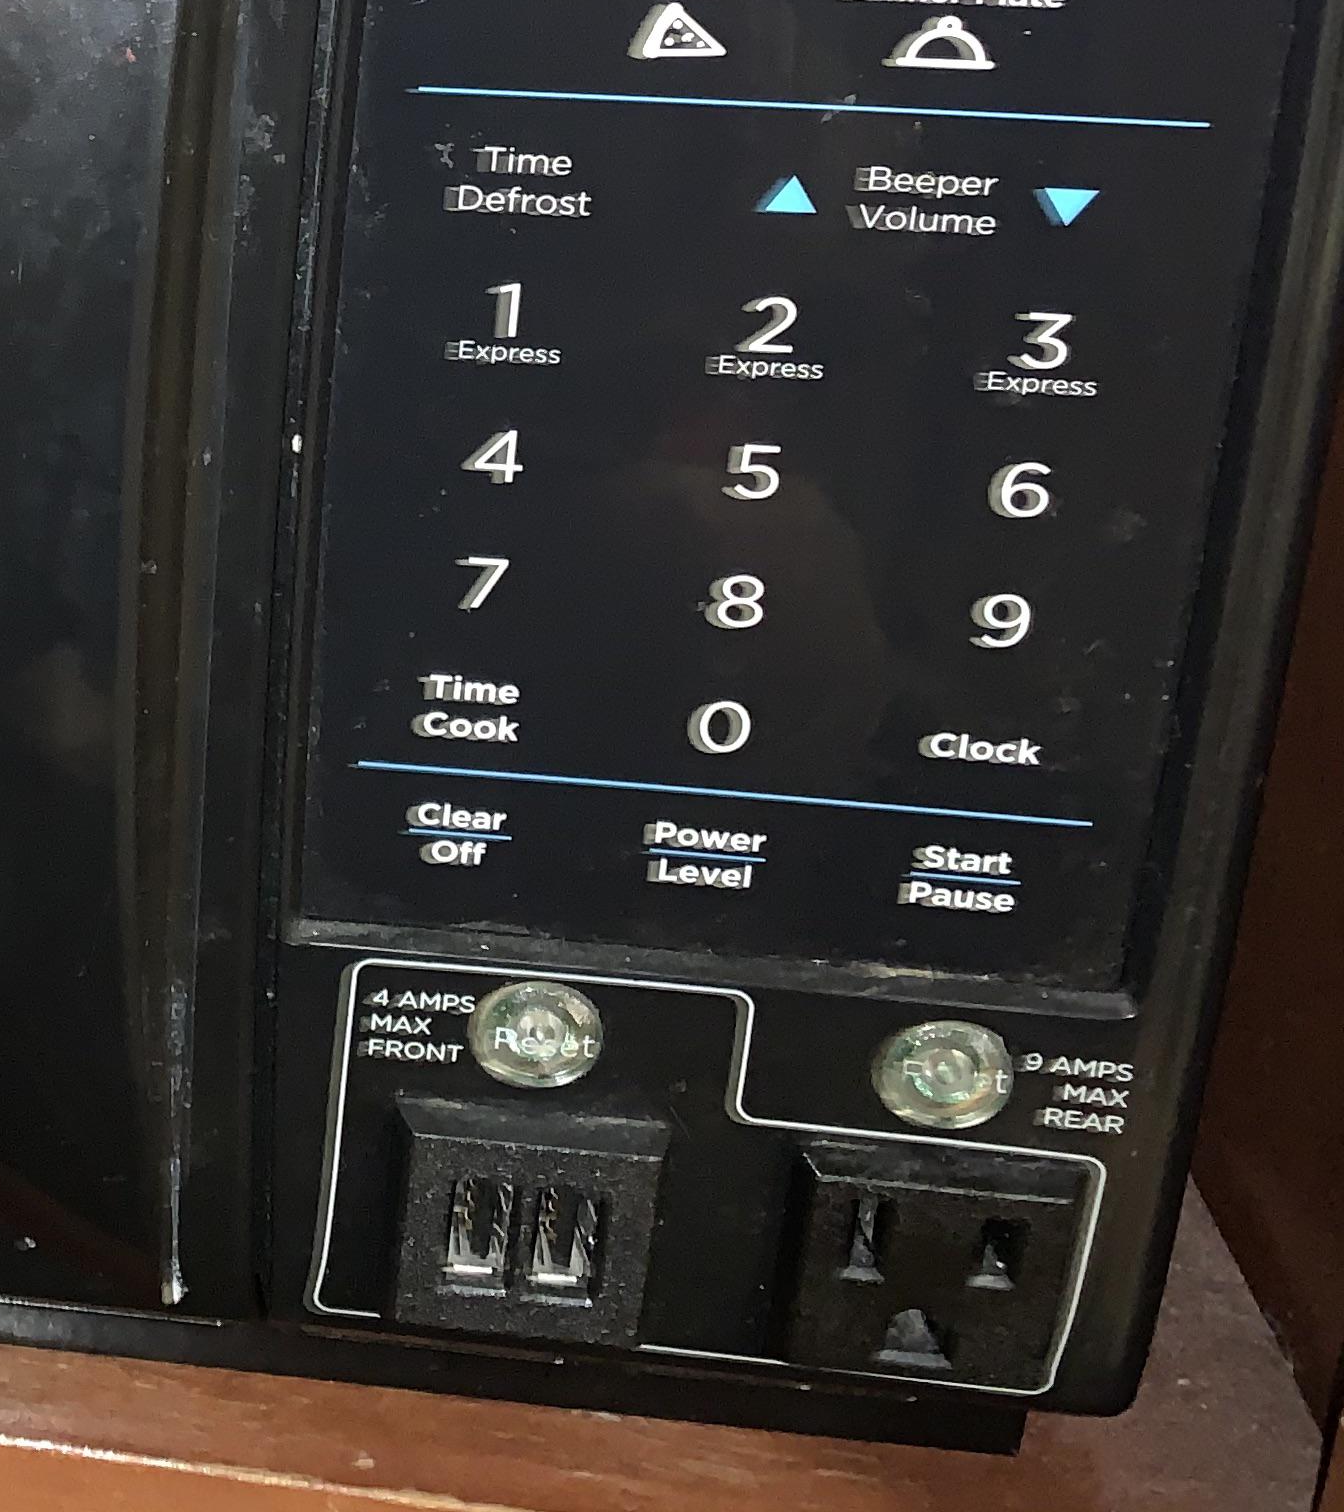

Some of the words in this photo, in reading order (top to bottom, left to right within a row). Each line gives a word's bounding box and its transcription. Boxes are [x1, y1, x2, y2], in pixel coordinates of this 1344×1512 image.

[482, 145, 573, 177] Time
[867, 165, 1000, 200] Beeper
[456, 184, 593, 217] Defrost
[858, 202, 997, 236] Volume
[498, 282, 522, 339] 1
[746, 295, 798, 354] 2
[455, 337, 563, 367] Express
[1019, 311, 1074, 371] 3
[716, 352, 826, 382] Express
[985, 369, 1099, 399] Express
[473, 429, 524, 484] 4
[732, 443, 782, 500] 5
[1000, 461, 1052, 519] 6
[467, 555, 510, 610] 7
[716, 574, 766, 629] 8
[979, 593, 1032, 649] 9
[428, 673, 521, 705] Time
[422, 710, 520, 743] Cook
[698, 700, 752, 754] 0
[929, 731, 1042, 766] Clock
[415, 801, 509, 832] Clear
[430, 839, 488, 866] Off
[653, 820, 768, 853] Power
[656, 858, 753, 890] Level
[923, 844, 1014, 876] Start
[908, 880, 1016, 914] Pause
[372, 988, 389, 1006] 4
[398, 990, 475, 1013] AMPS
[370, 1013, 432, 1036] MAX
[367, 1039, 464, 1063] FRONT
[1025, 1052, 1043, 1071] 9
[1050, 1056, 1134, 1082] AMPS
[1063, 1084, 1129, 1108] MAX
[1043, 1107, 1125, 1134] REAR
